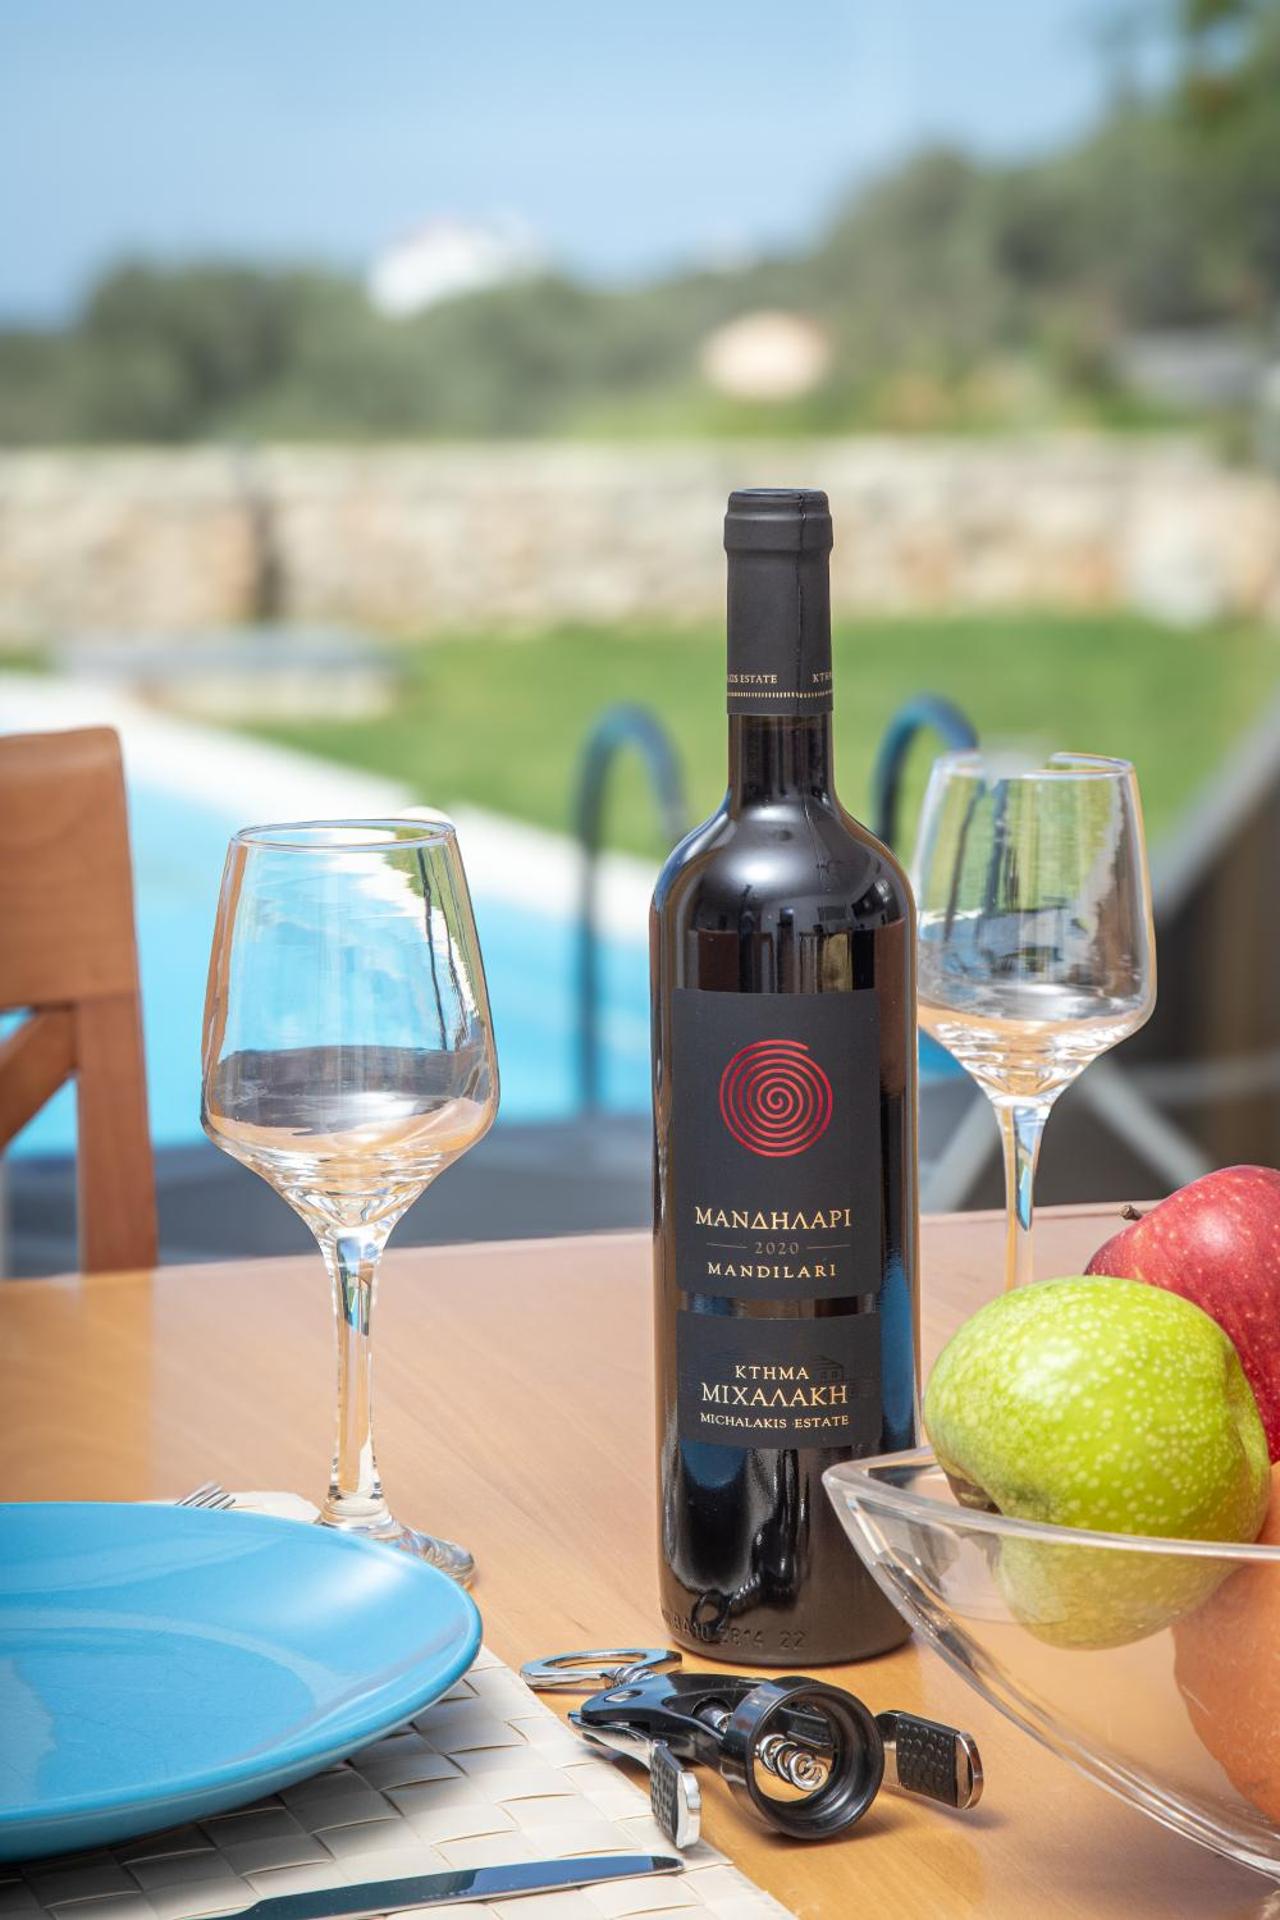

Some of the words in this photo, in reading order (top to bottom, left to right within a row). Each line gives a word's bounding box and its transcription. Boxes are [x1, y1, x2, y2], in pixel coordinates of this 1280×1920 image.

[740, 674, 778, 684] ESTATE
[695, 1206, 852, 1230] ΜΑΝΔΗΛΑΡΙ
[755, 1242, 799, 1255] 2020
[707, 1262, 836, 1278] MANDILARI
[735, 1365, 809, 1380] ΚΤΗΜΑ
[701, 1382, 848, 1407] ΜΙΧΑΛΑΚΗ
[700, 1412, 787, 1429] MICHALAKIS
[795, 1414, 849, 1428] ESTATE
